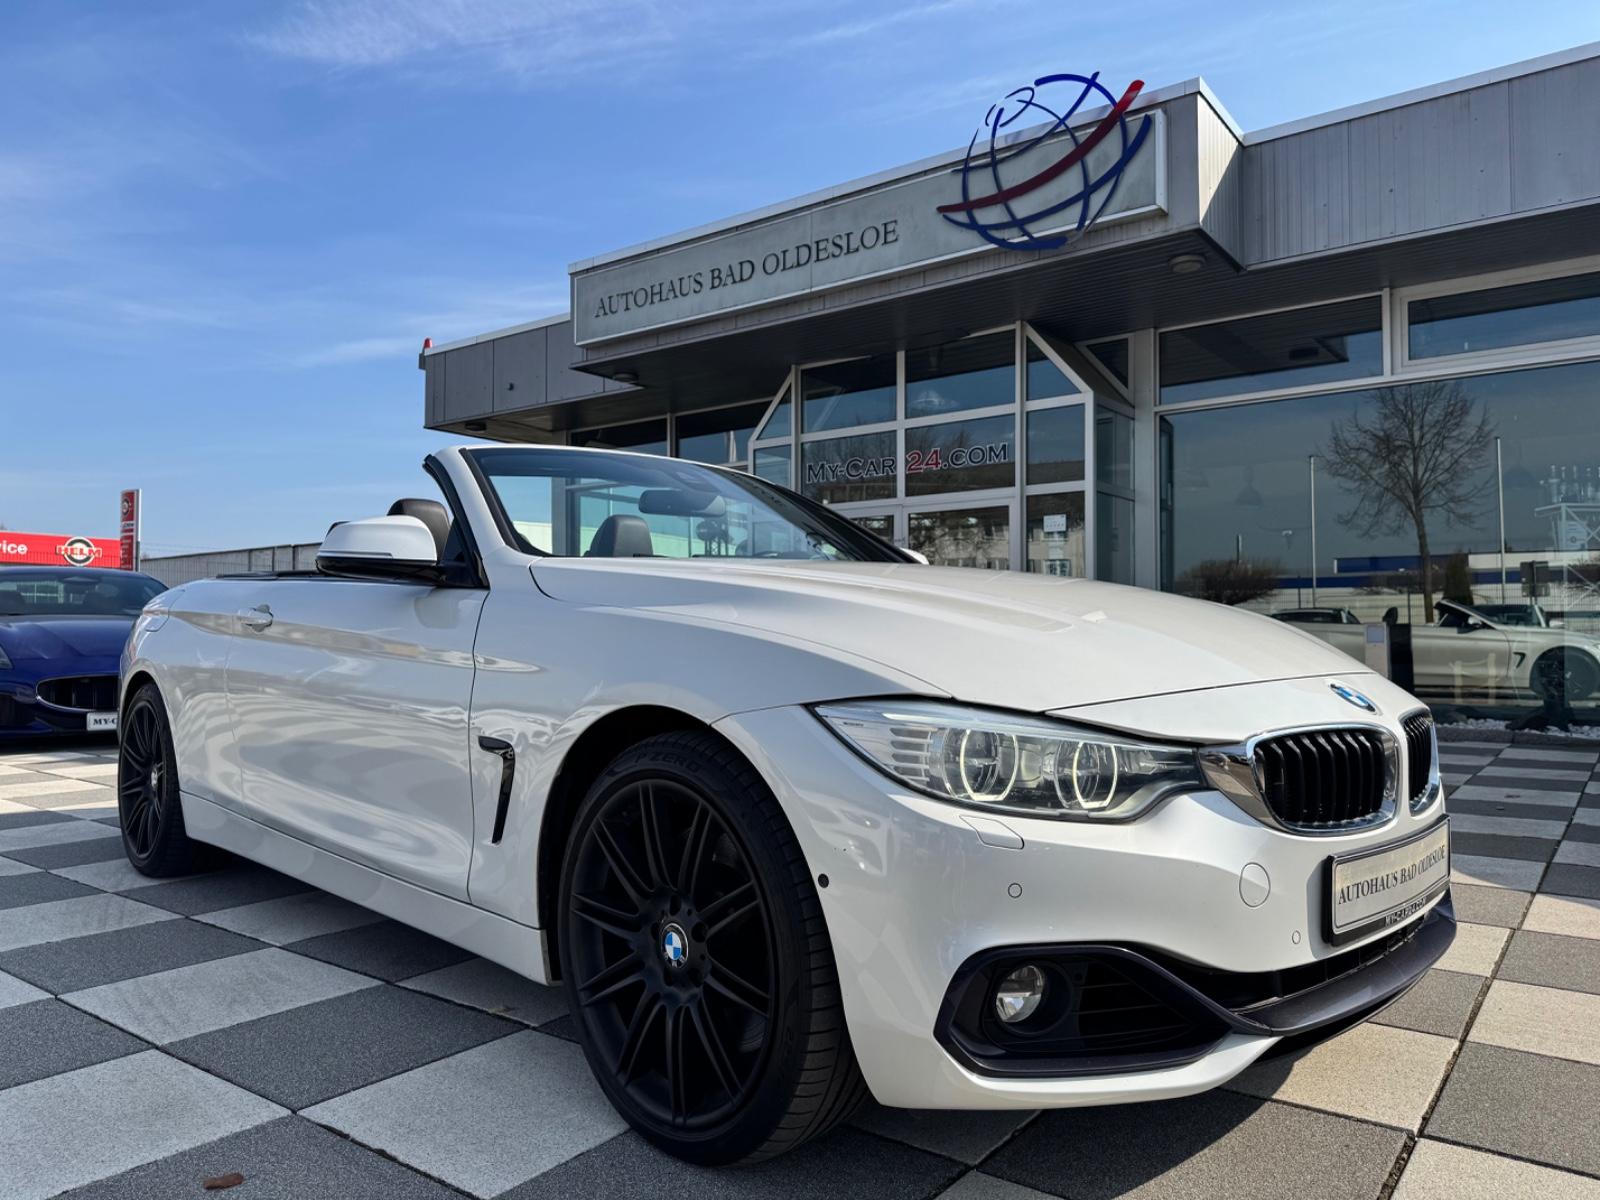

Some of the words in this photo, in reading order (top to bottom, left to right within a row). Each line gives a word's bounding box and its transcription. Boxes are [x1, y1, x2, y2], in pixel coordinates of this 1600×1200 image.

[595, 272, 703, 318] AUTOHAUS
[709, 259, 755, 290] BAD
[762, 219, 899, 276] OLDESLOE
[0, 539, 28, 556] ice
[1338, 870, 1398, 905] AUTOHAUS
[1400, 863, 1416, 885] BAD
